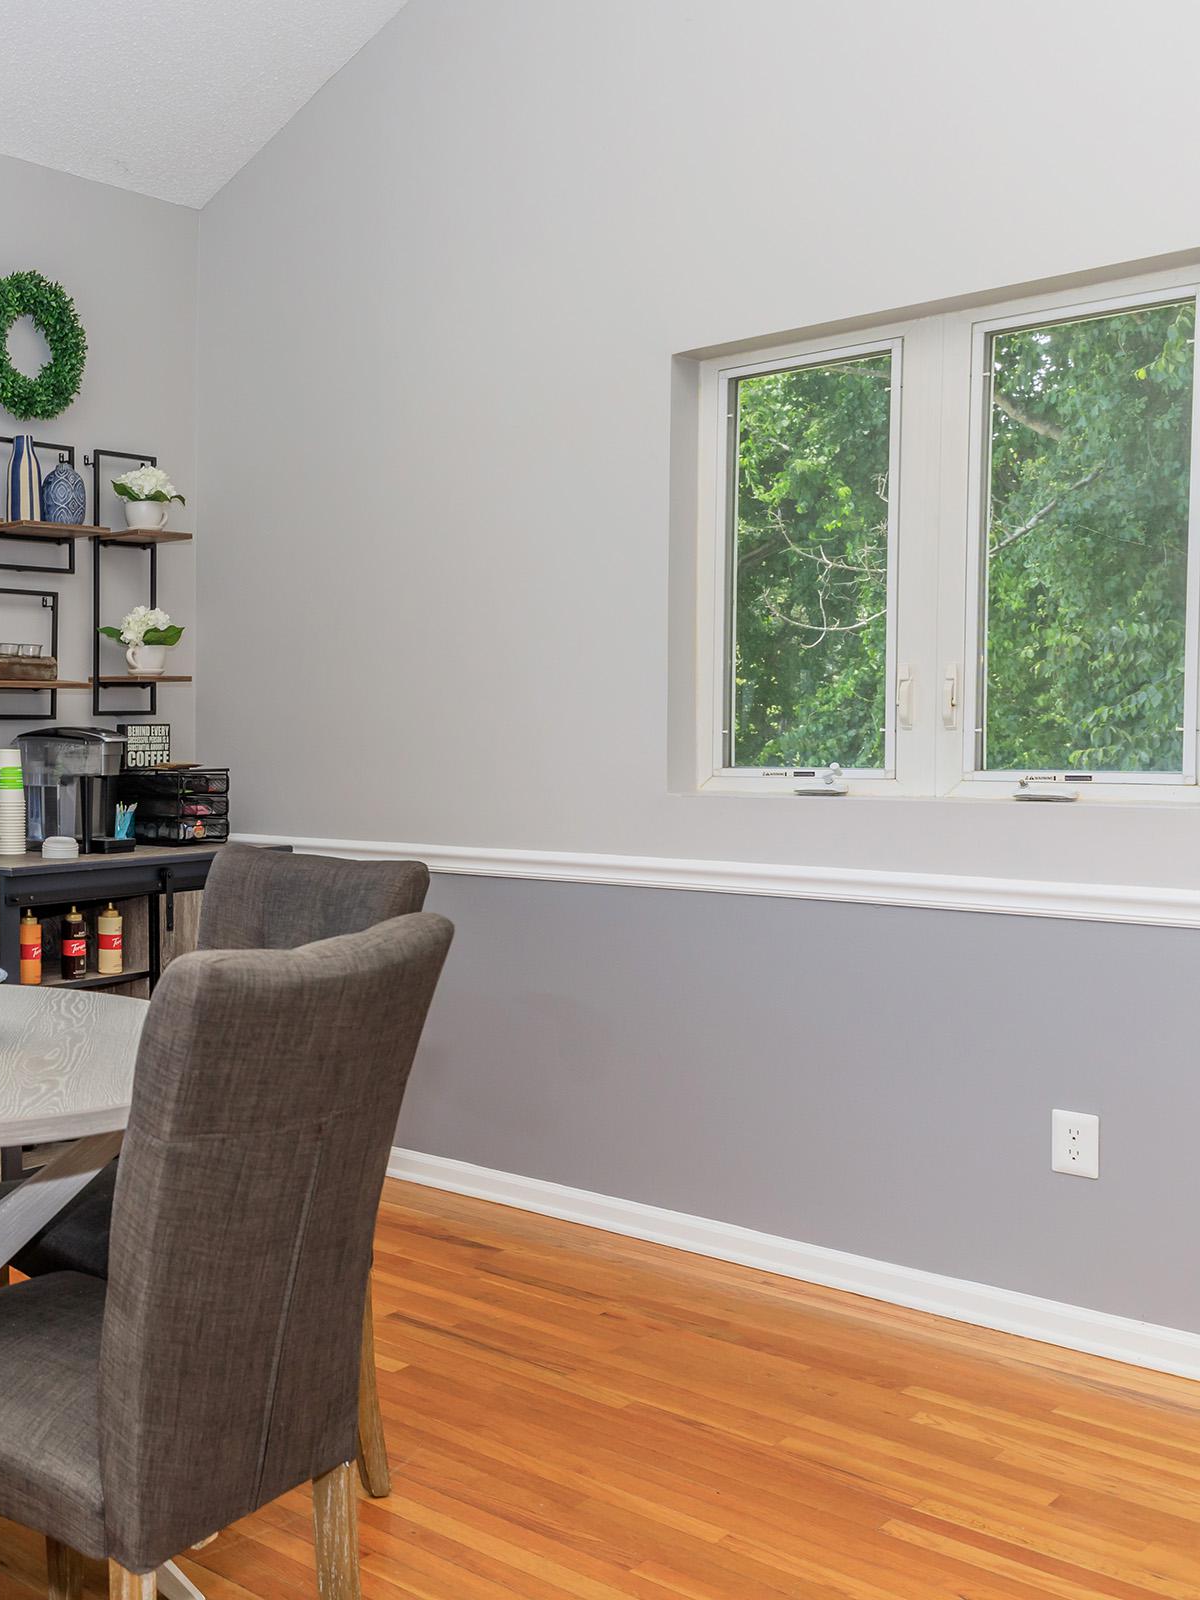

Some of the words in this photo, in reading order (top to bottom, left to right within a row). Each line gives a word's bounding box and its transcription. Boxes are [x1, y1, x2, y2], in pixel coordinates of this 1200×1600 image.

[128, 725, 150, 737] BEHIND
[151, 725, 169, 736] EVERY
[127, 750, 170, 767] COFFEE
